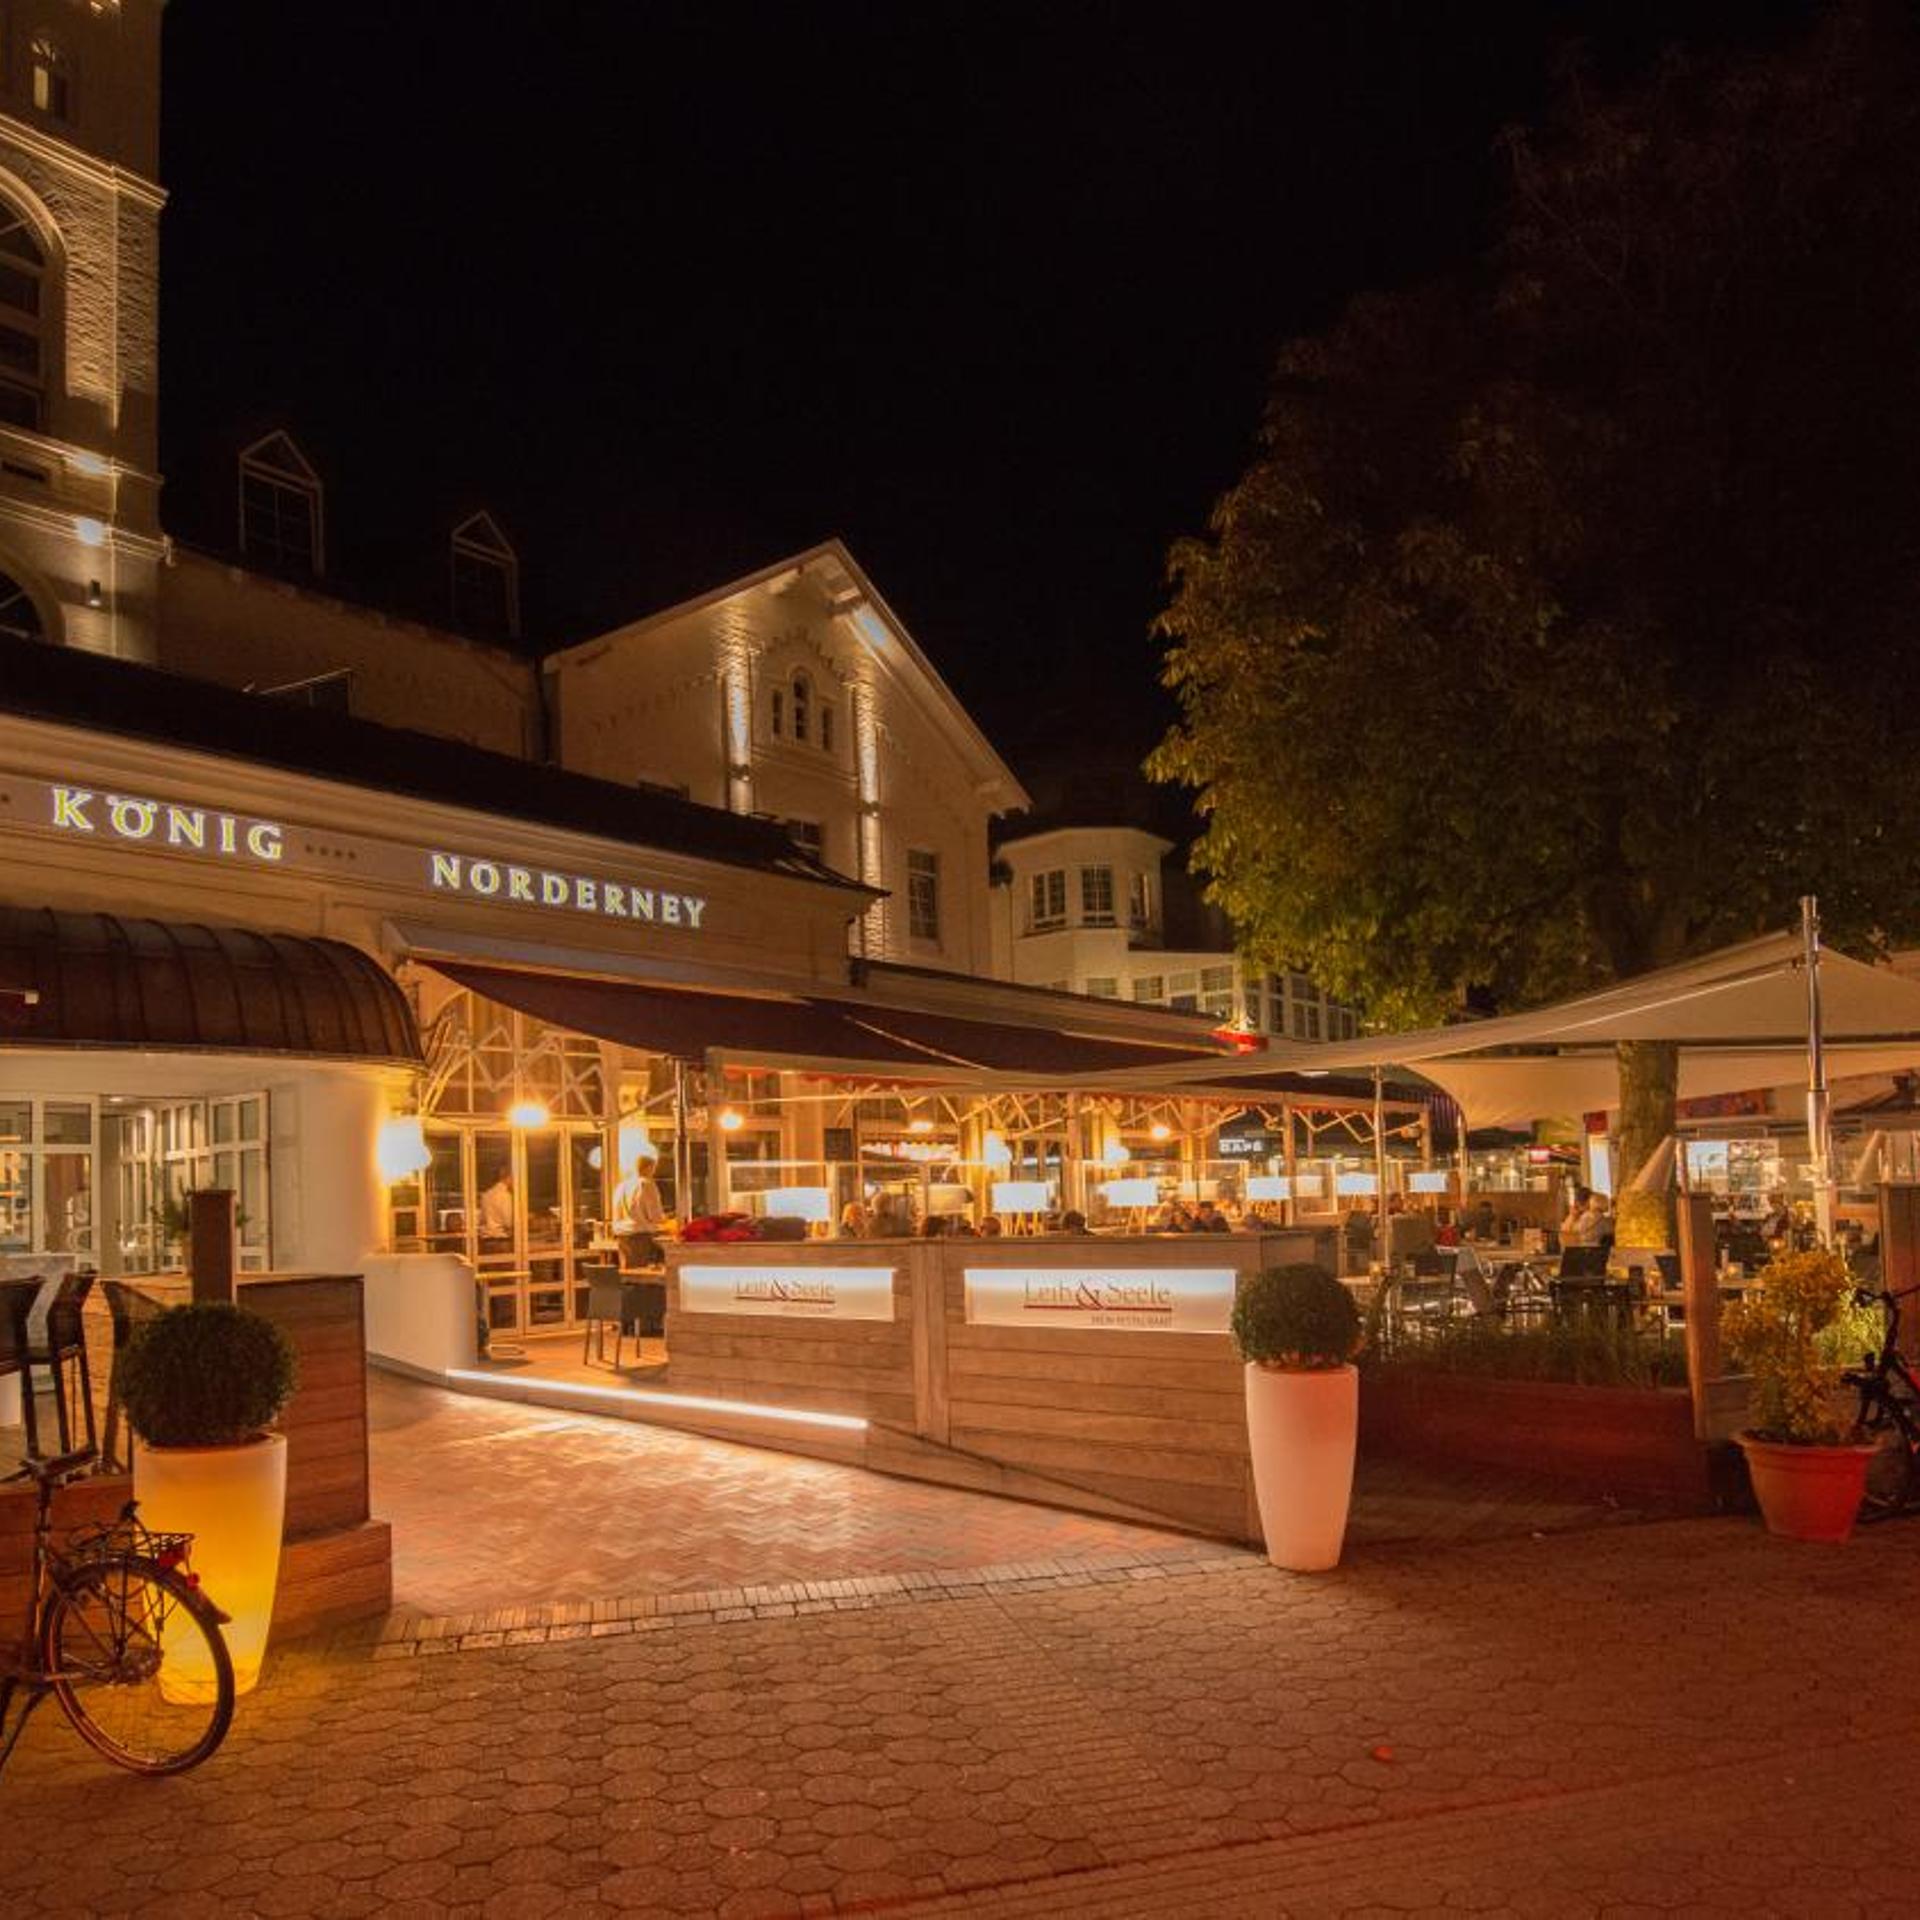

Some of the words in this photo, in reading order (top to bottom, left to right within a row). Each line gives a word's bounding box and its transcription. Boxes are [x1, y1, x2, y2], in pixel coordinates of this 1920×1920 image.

[53, 787, 282, 860] KÖNIG
[431, 853, 706, 928] NORDERNEY
[1075, 1276, 1104, 1309] &
[1106, 1279, 1171, 1305] Seele
